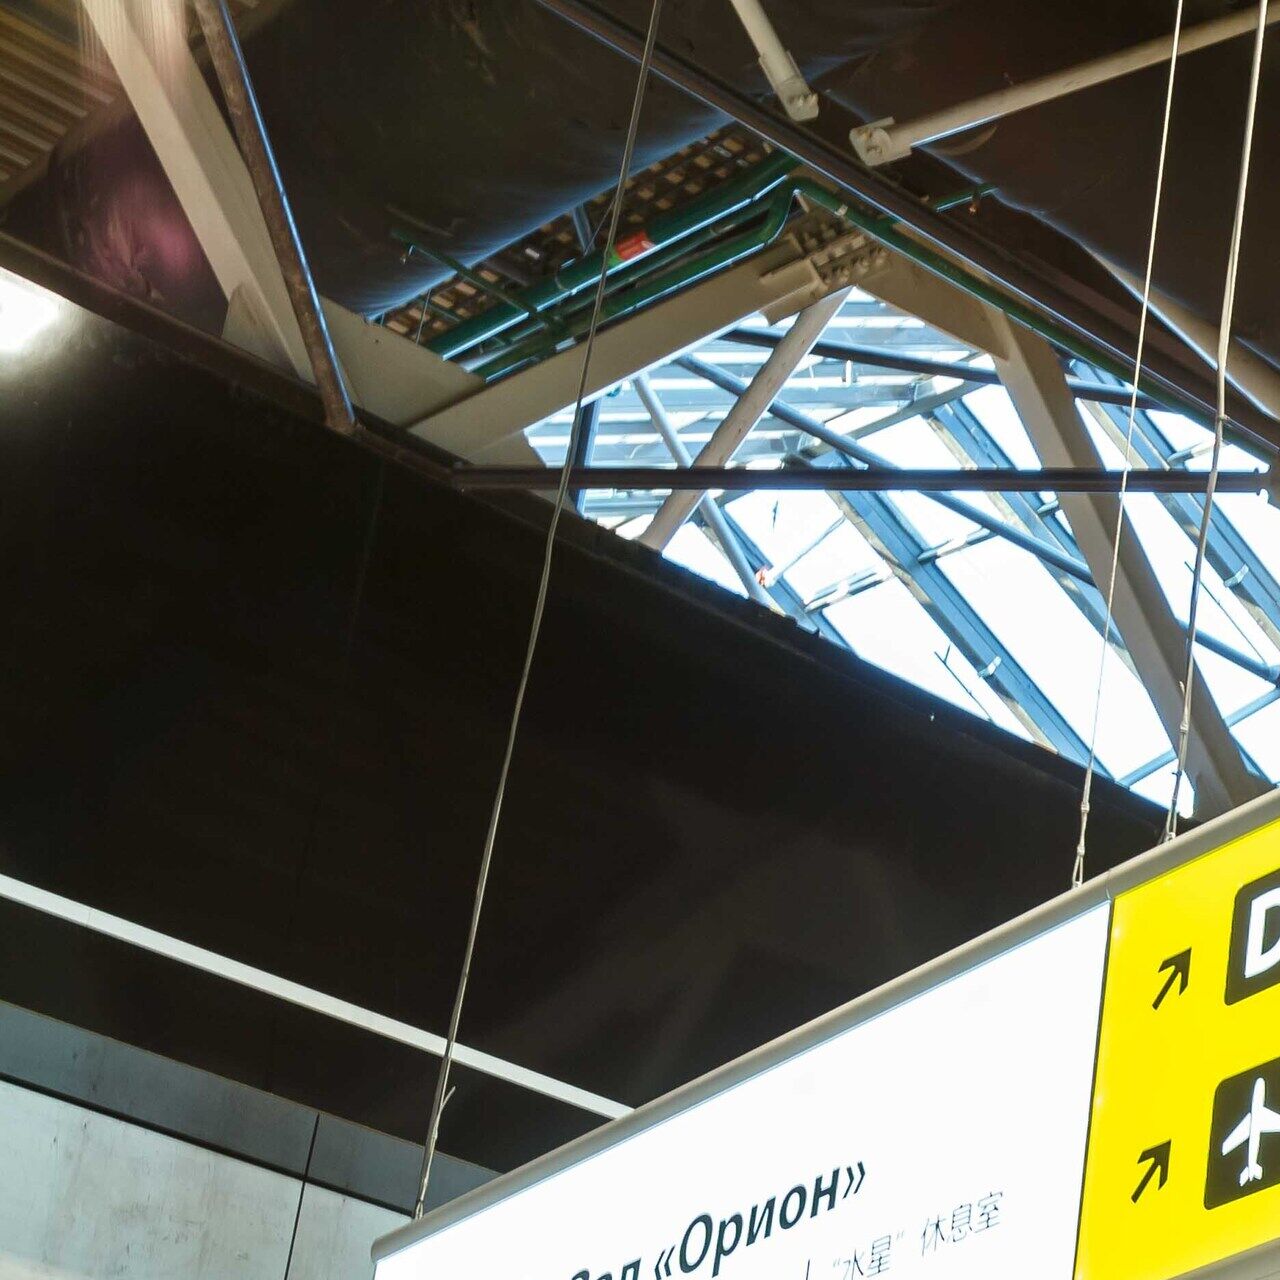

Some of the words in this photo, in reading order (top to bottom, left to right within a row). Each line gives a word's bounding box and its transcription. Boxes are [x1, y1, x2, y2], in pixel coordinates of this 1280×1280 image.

[654, 1160, 866, 1280] «Орион»
[921, 1191, 1003, 1256] 休息室
